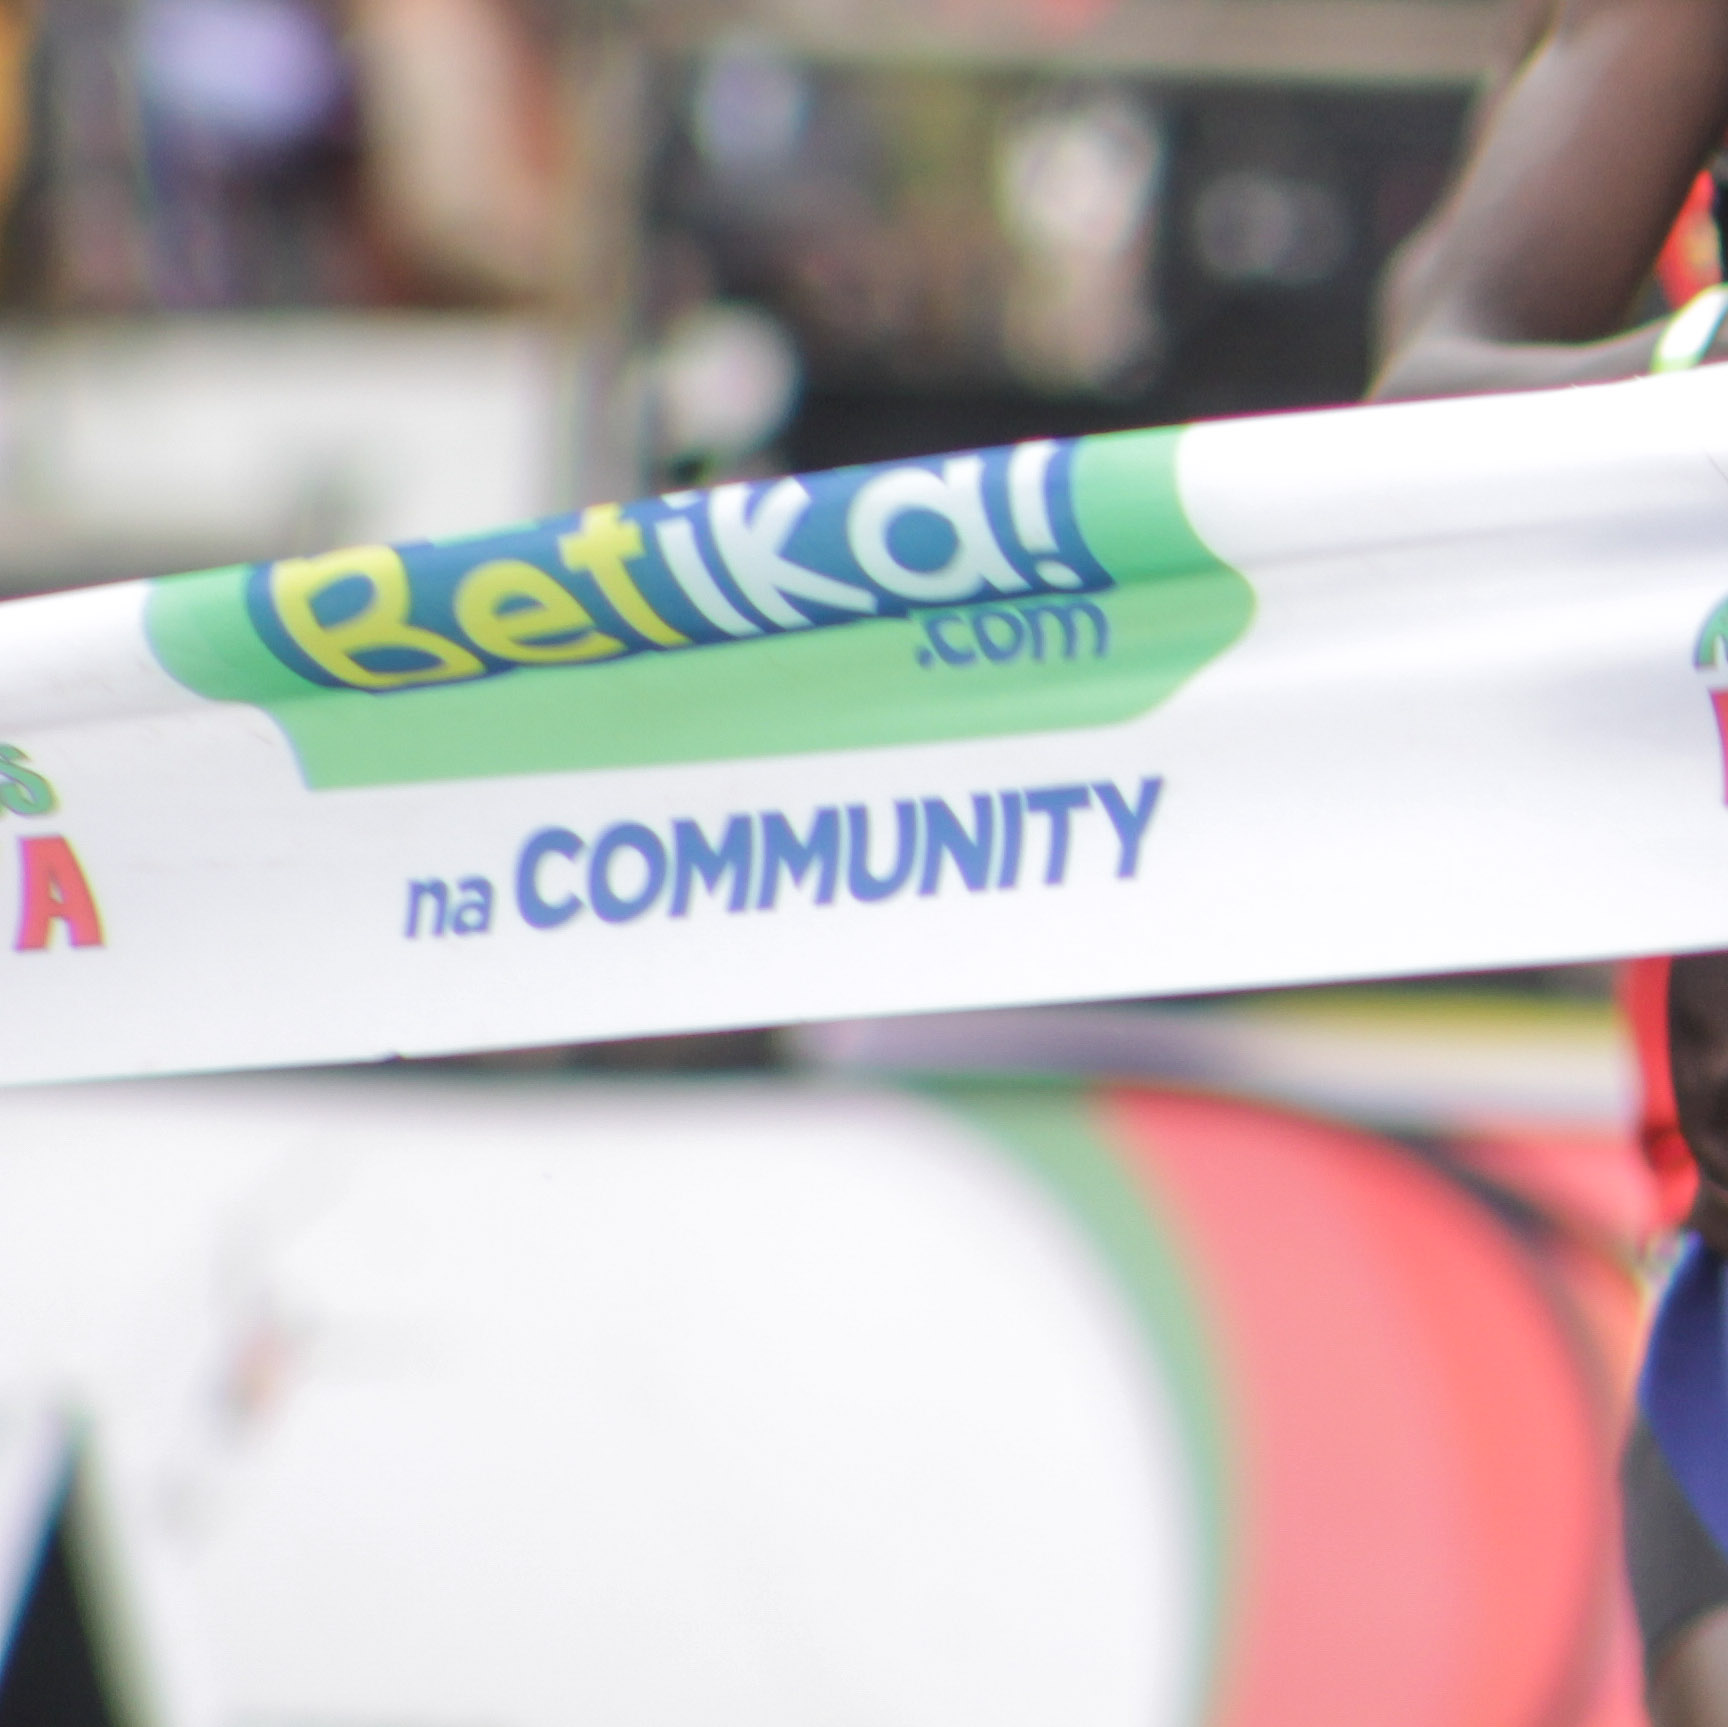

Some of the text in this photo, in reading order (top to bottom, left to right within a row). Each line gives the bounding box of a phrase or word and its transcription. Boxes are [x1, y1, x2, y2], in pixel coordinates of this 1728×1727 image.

[270, 436, 1086, 692] Betika!
[915, 597, 1112, 670] .com
[404, 775, 1164, 939] na COMMUNITY
